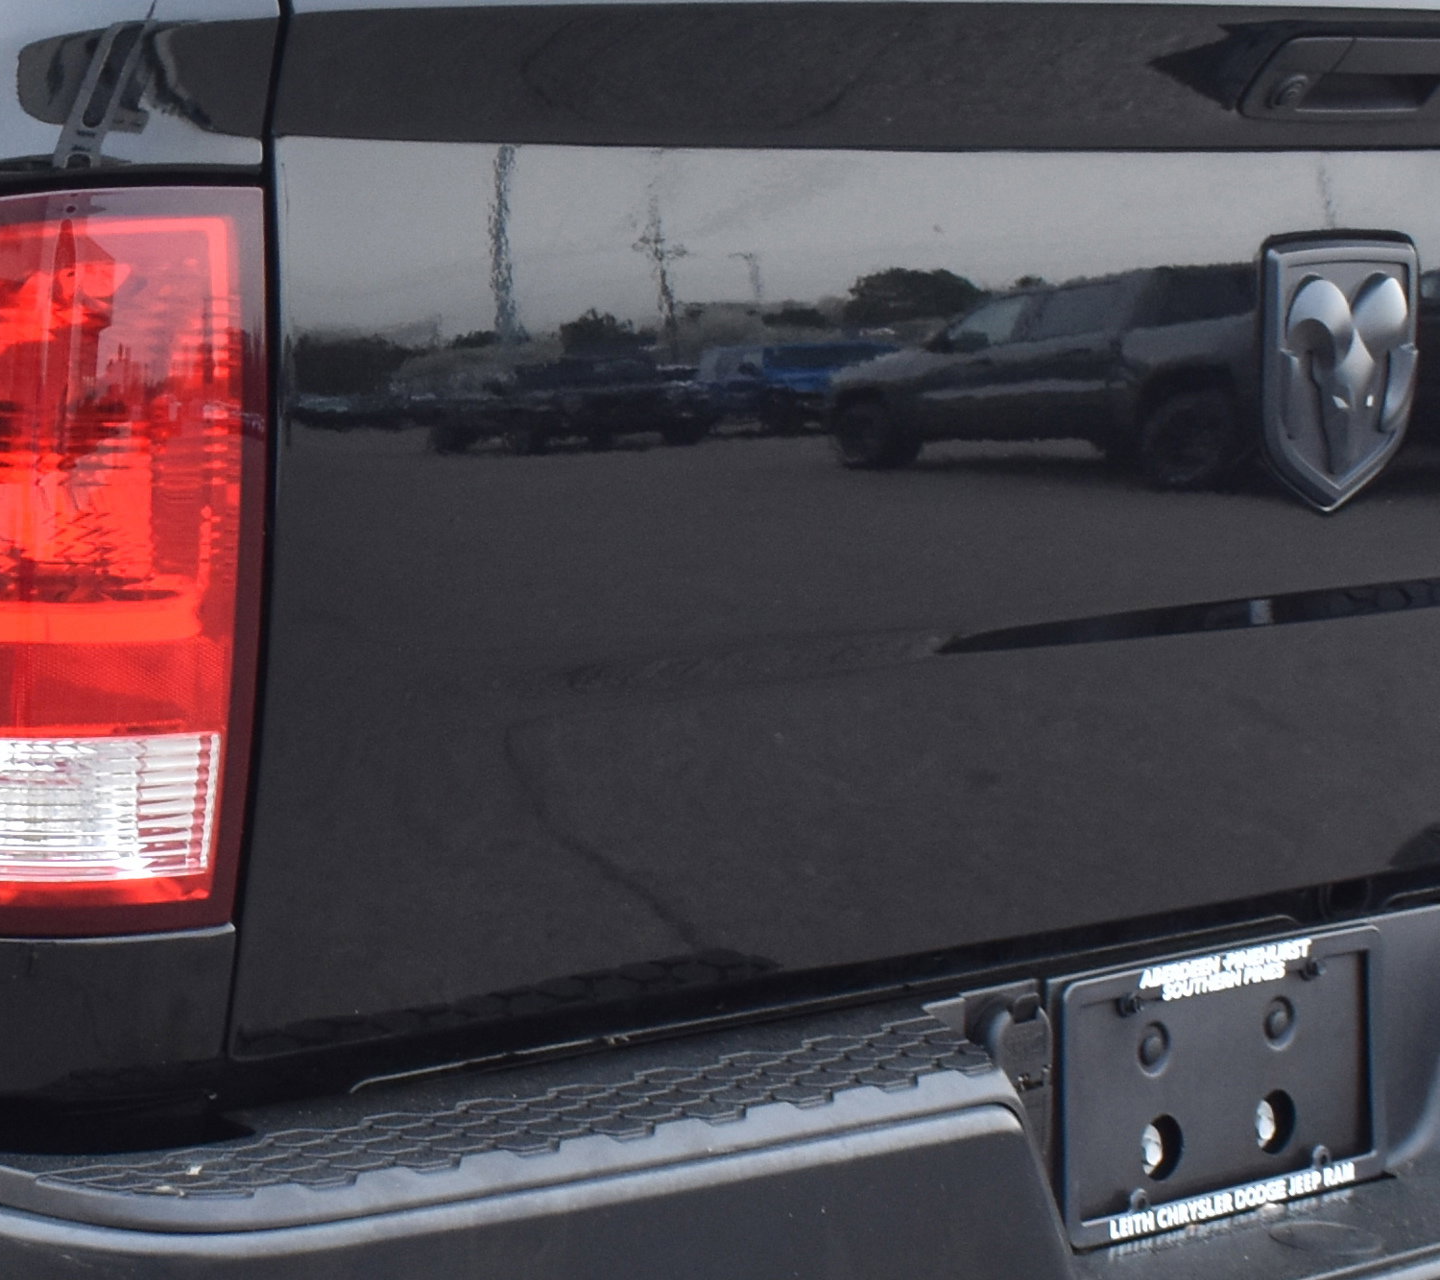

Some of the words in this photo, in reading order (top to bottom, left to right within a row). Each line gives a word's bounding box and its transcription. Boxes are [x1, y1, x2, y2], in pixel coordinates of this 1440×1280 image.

[1109, 1210, 1156, 1240] LEITH
[1157, 1193, 1235, 1230] CHRYSLER
[1234, 1179, 1288, 1211] DODGE
[1288, 1170, 1322, 1197] JEEP
[1322, 1161, 1356, 1187] RAM
